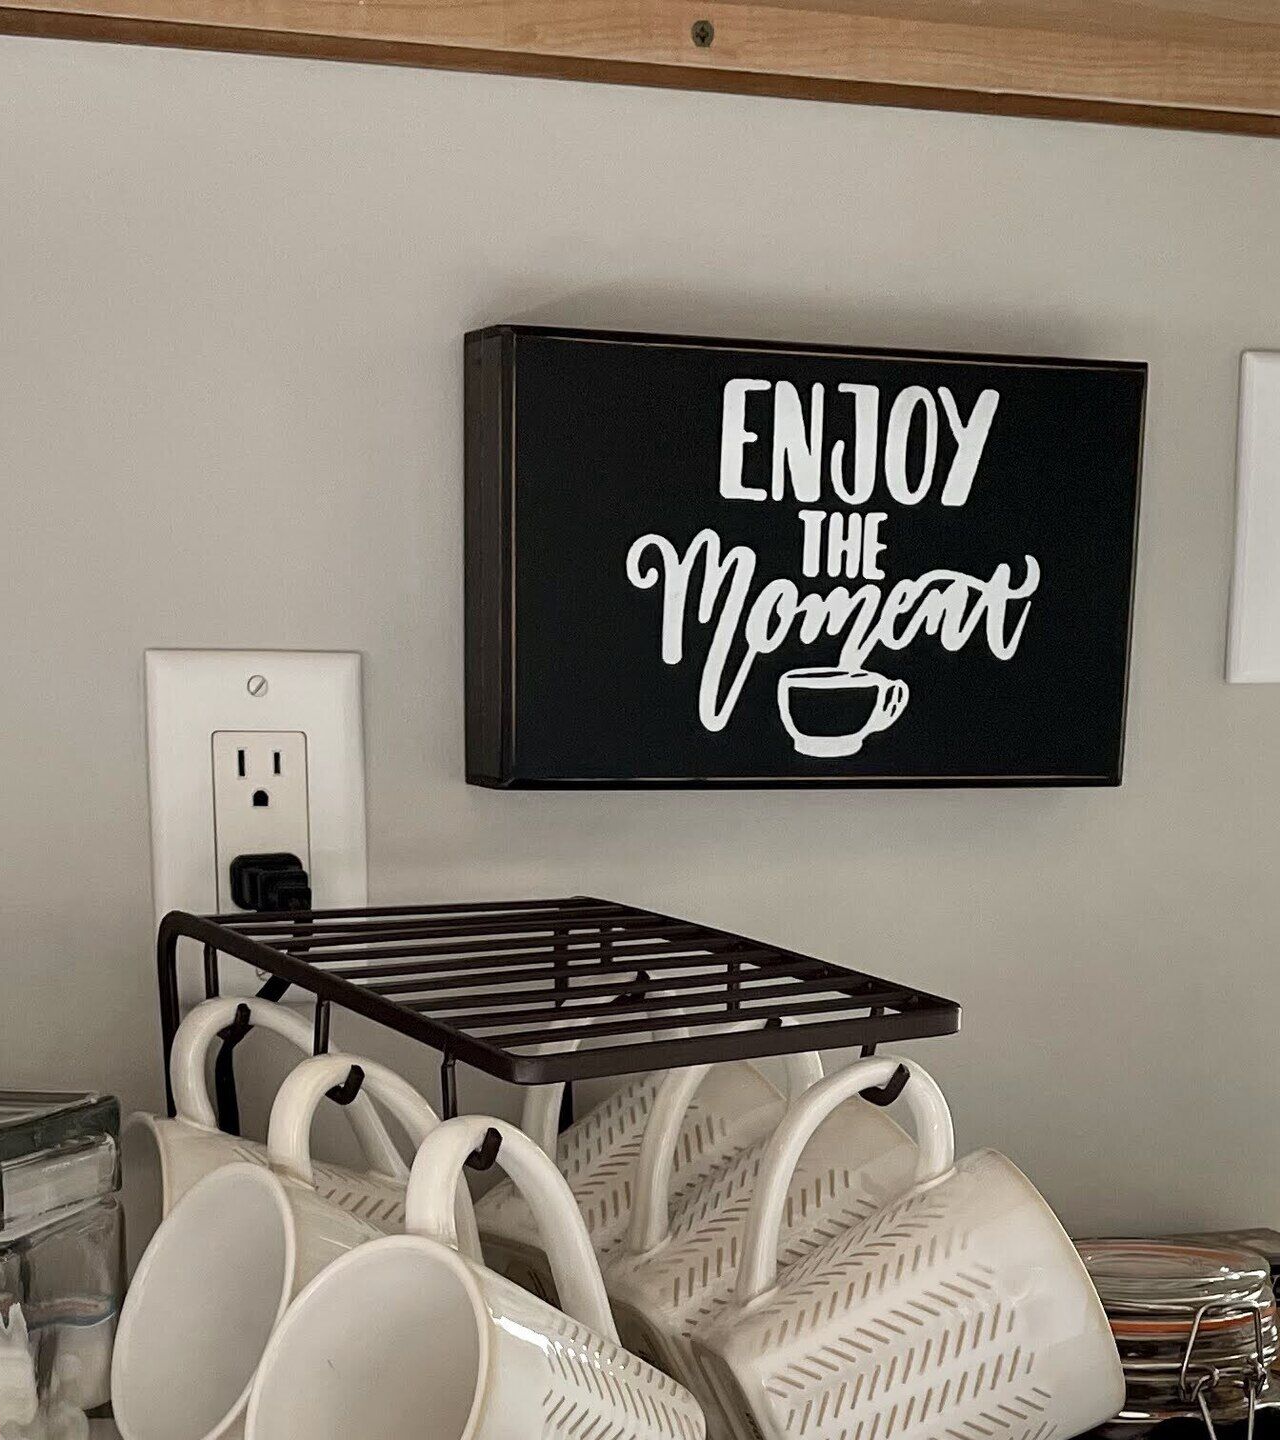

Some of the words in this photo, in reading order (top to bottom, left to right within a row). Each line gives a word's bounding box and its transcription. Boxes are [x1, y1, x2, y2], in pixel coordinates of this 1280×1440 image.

[720, 378, 1000, 507] ENJOY
[798, 510, 888, 580] THE
[626, 528, 1041, 732] Moment
